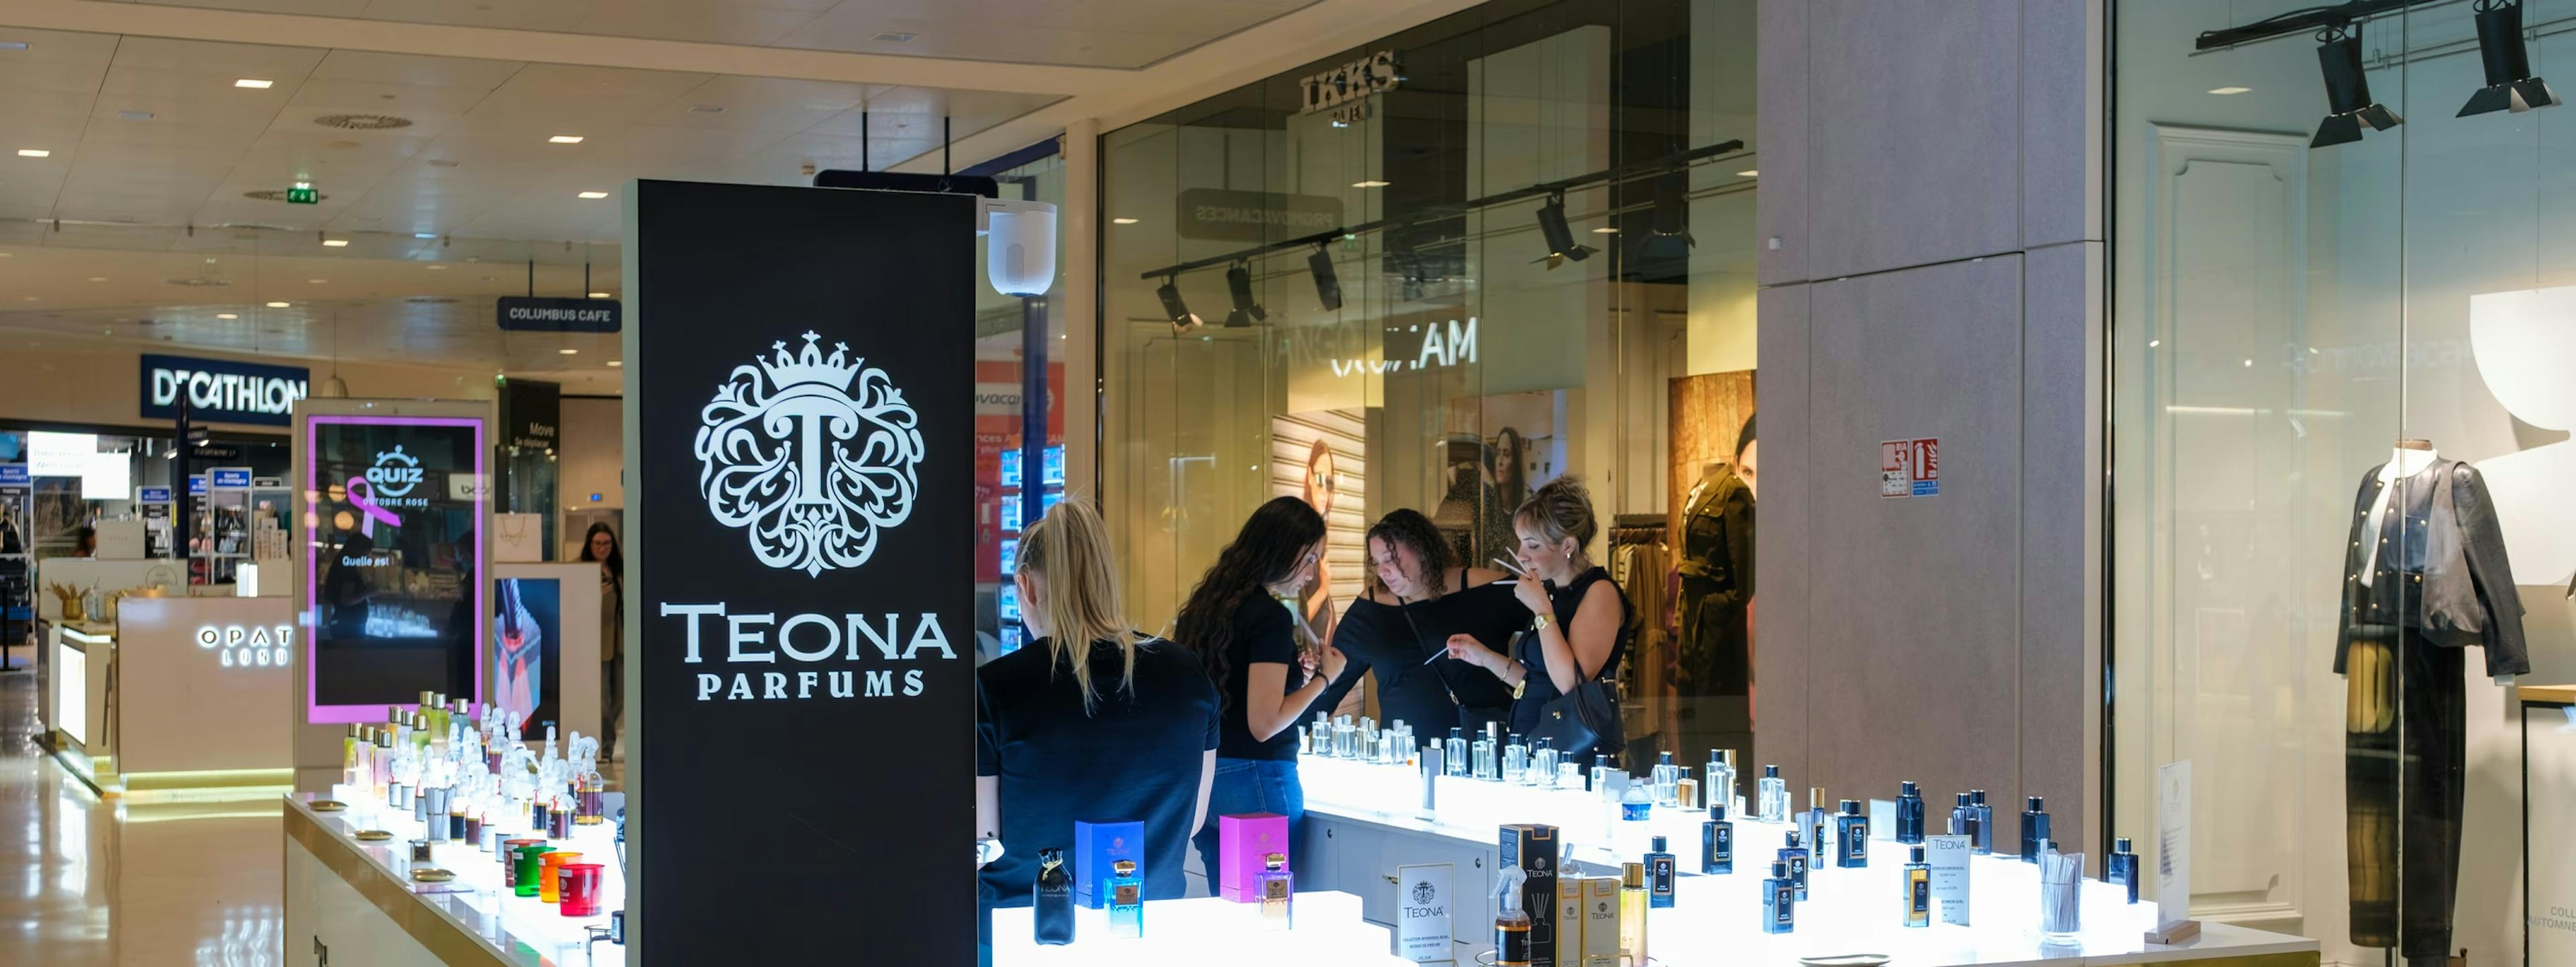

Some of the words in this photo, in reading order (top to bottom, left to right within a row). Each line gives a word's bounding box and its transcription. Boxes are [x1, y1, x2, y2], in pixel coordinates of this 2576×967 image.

[1300, 49, 1397, 114] IKKS
[510, 307, 576, 321] COLUMBUS
[578, 309, 610, 322] CAFE
[530, 422, 554, 437] Move
[366, 467, 423, 483] QUIZ
[405, 498, 429, 506] ROSE
[342, 555, 372, 566] Quelle
[374, 556, 388, 566] est
[697, 669, 924, 701] PARFUMS
[1933, 839, 1966, 850] TEONA
[1403, 907, 1444, 918] TEONA
